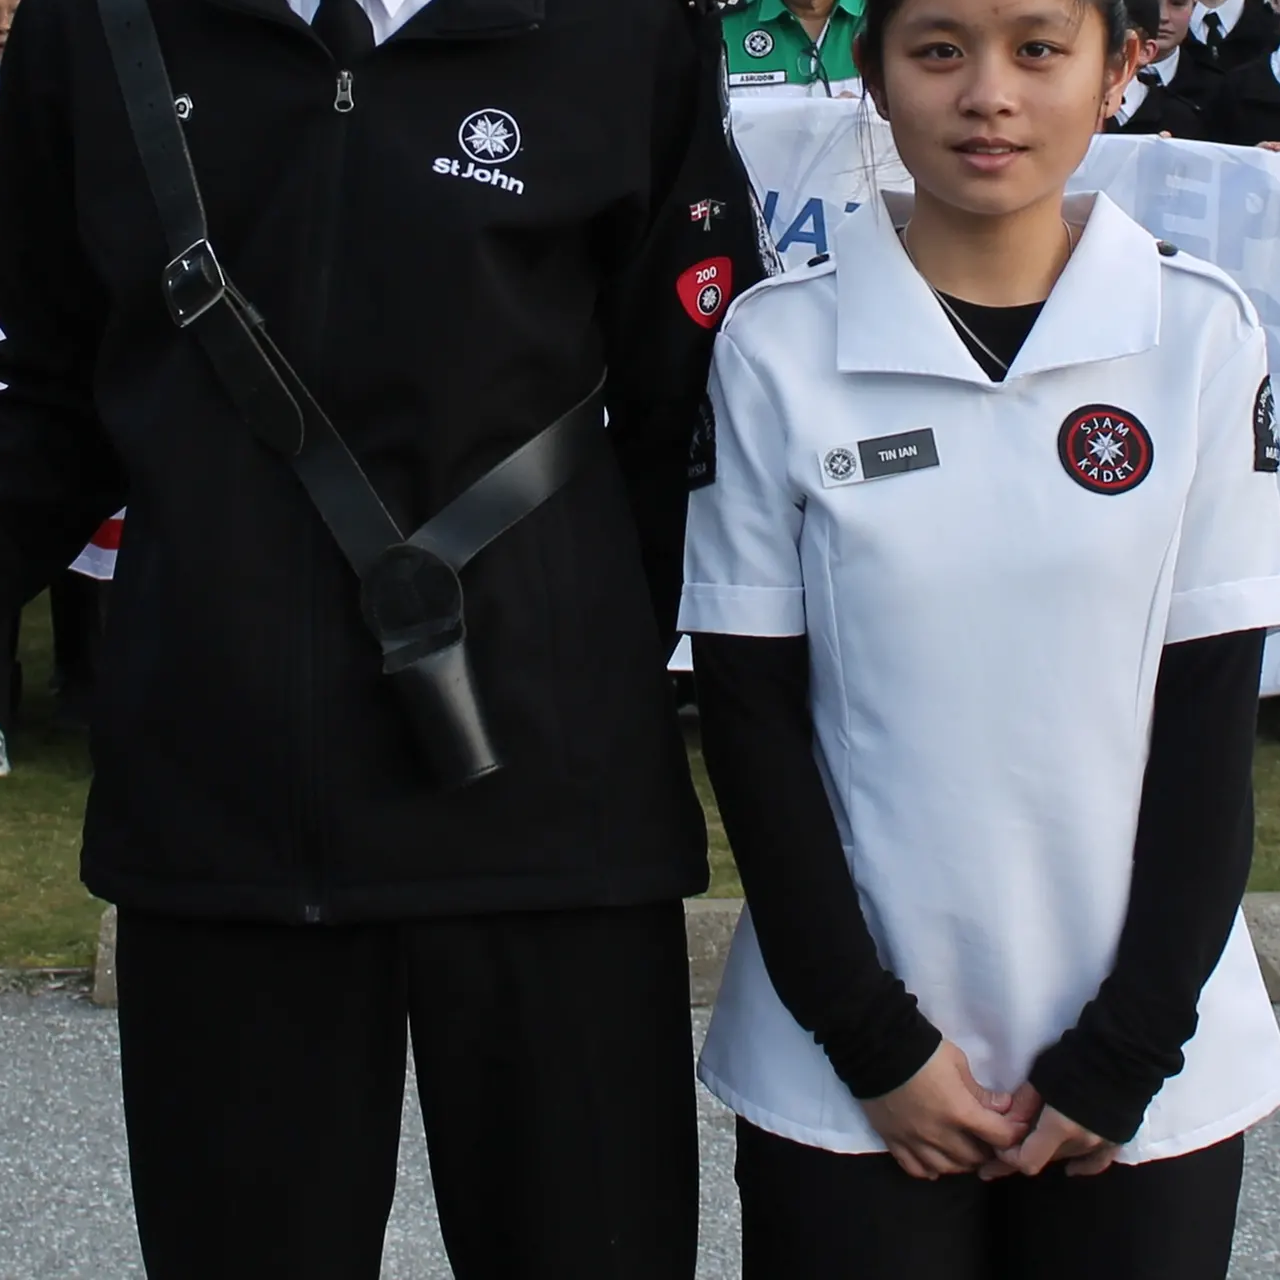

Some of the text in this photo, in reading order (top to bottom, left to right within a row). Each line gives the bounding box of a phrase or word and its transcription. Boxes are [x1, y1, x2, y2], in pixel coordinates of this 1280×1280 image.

[432, 157, 525, 195] St John
[695, 265, 718, 285] 200
[1080, 417, 1130, 437] SJAM
[877, 444, 918, 462] TIN IAN
[1076, 457, 1135, 483] KADET
